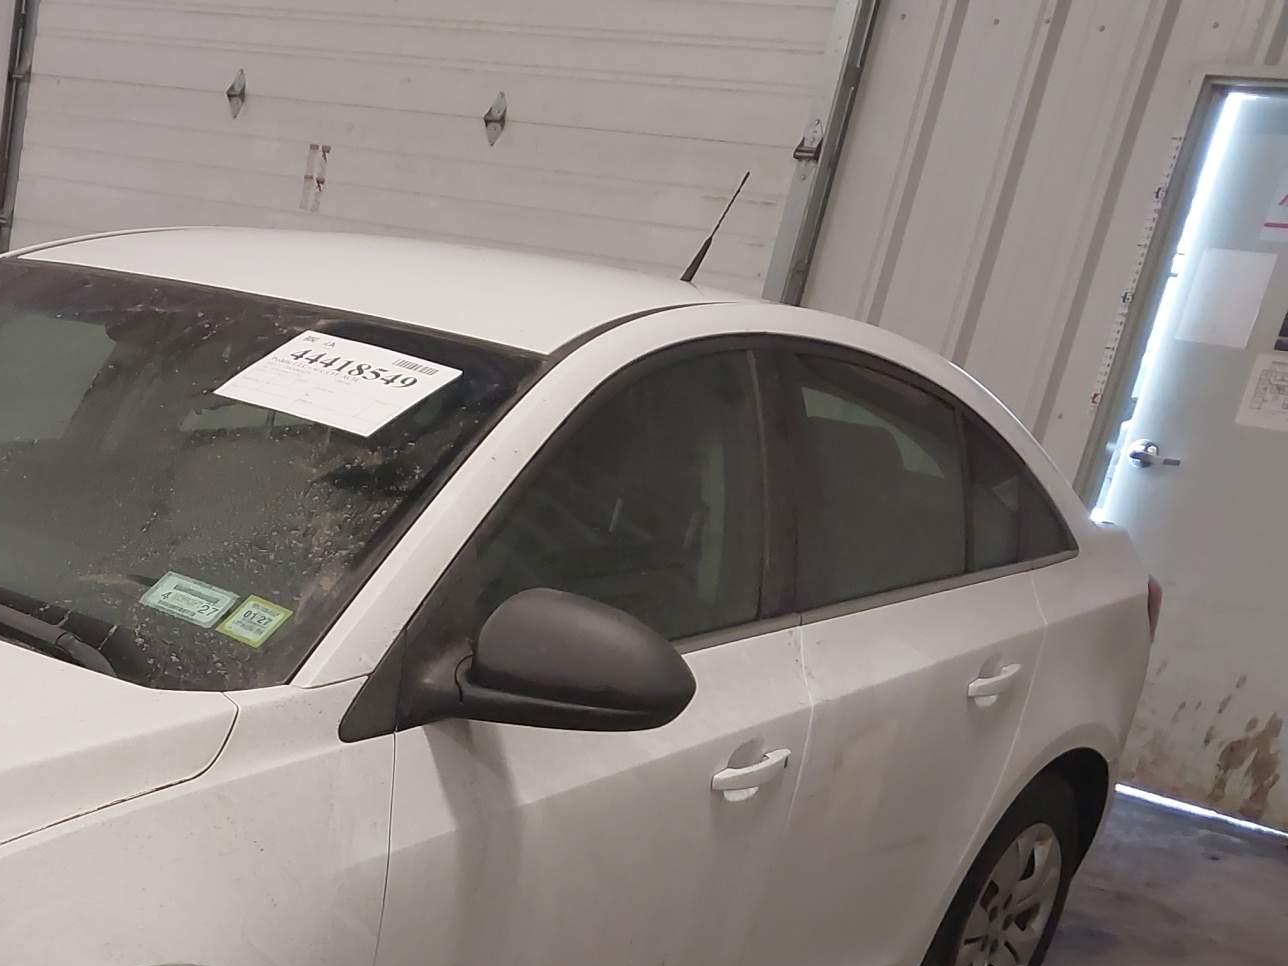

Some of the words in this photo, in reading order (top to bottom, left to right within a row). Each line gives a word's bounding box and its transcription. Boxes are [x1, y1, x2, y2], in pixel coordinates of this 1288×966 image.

[290, 348, 418, 389] 44418549
[161, 591, 173, 601] 4
[198, 604, 220, 617] 27
[243, 610, 258, 621] 01
[257, 615, 273, 626] 27
